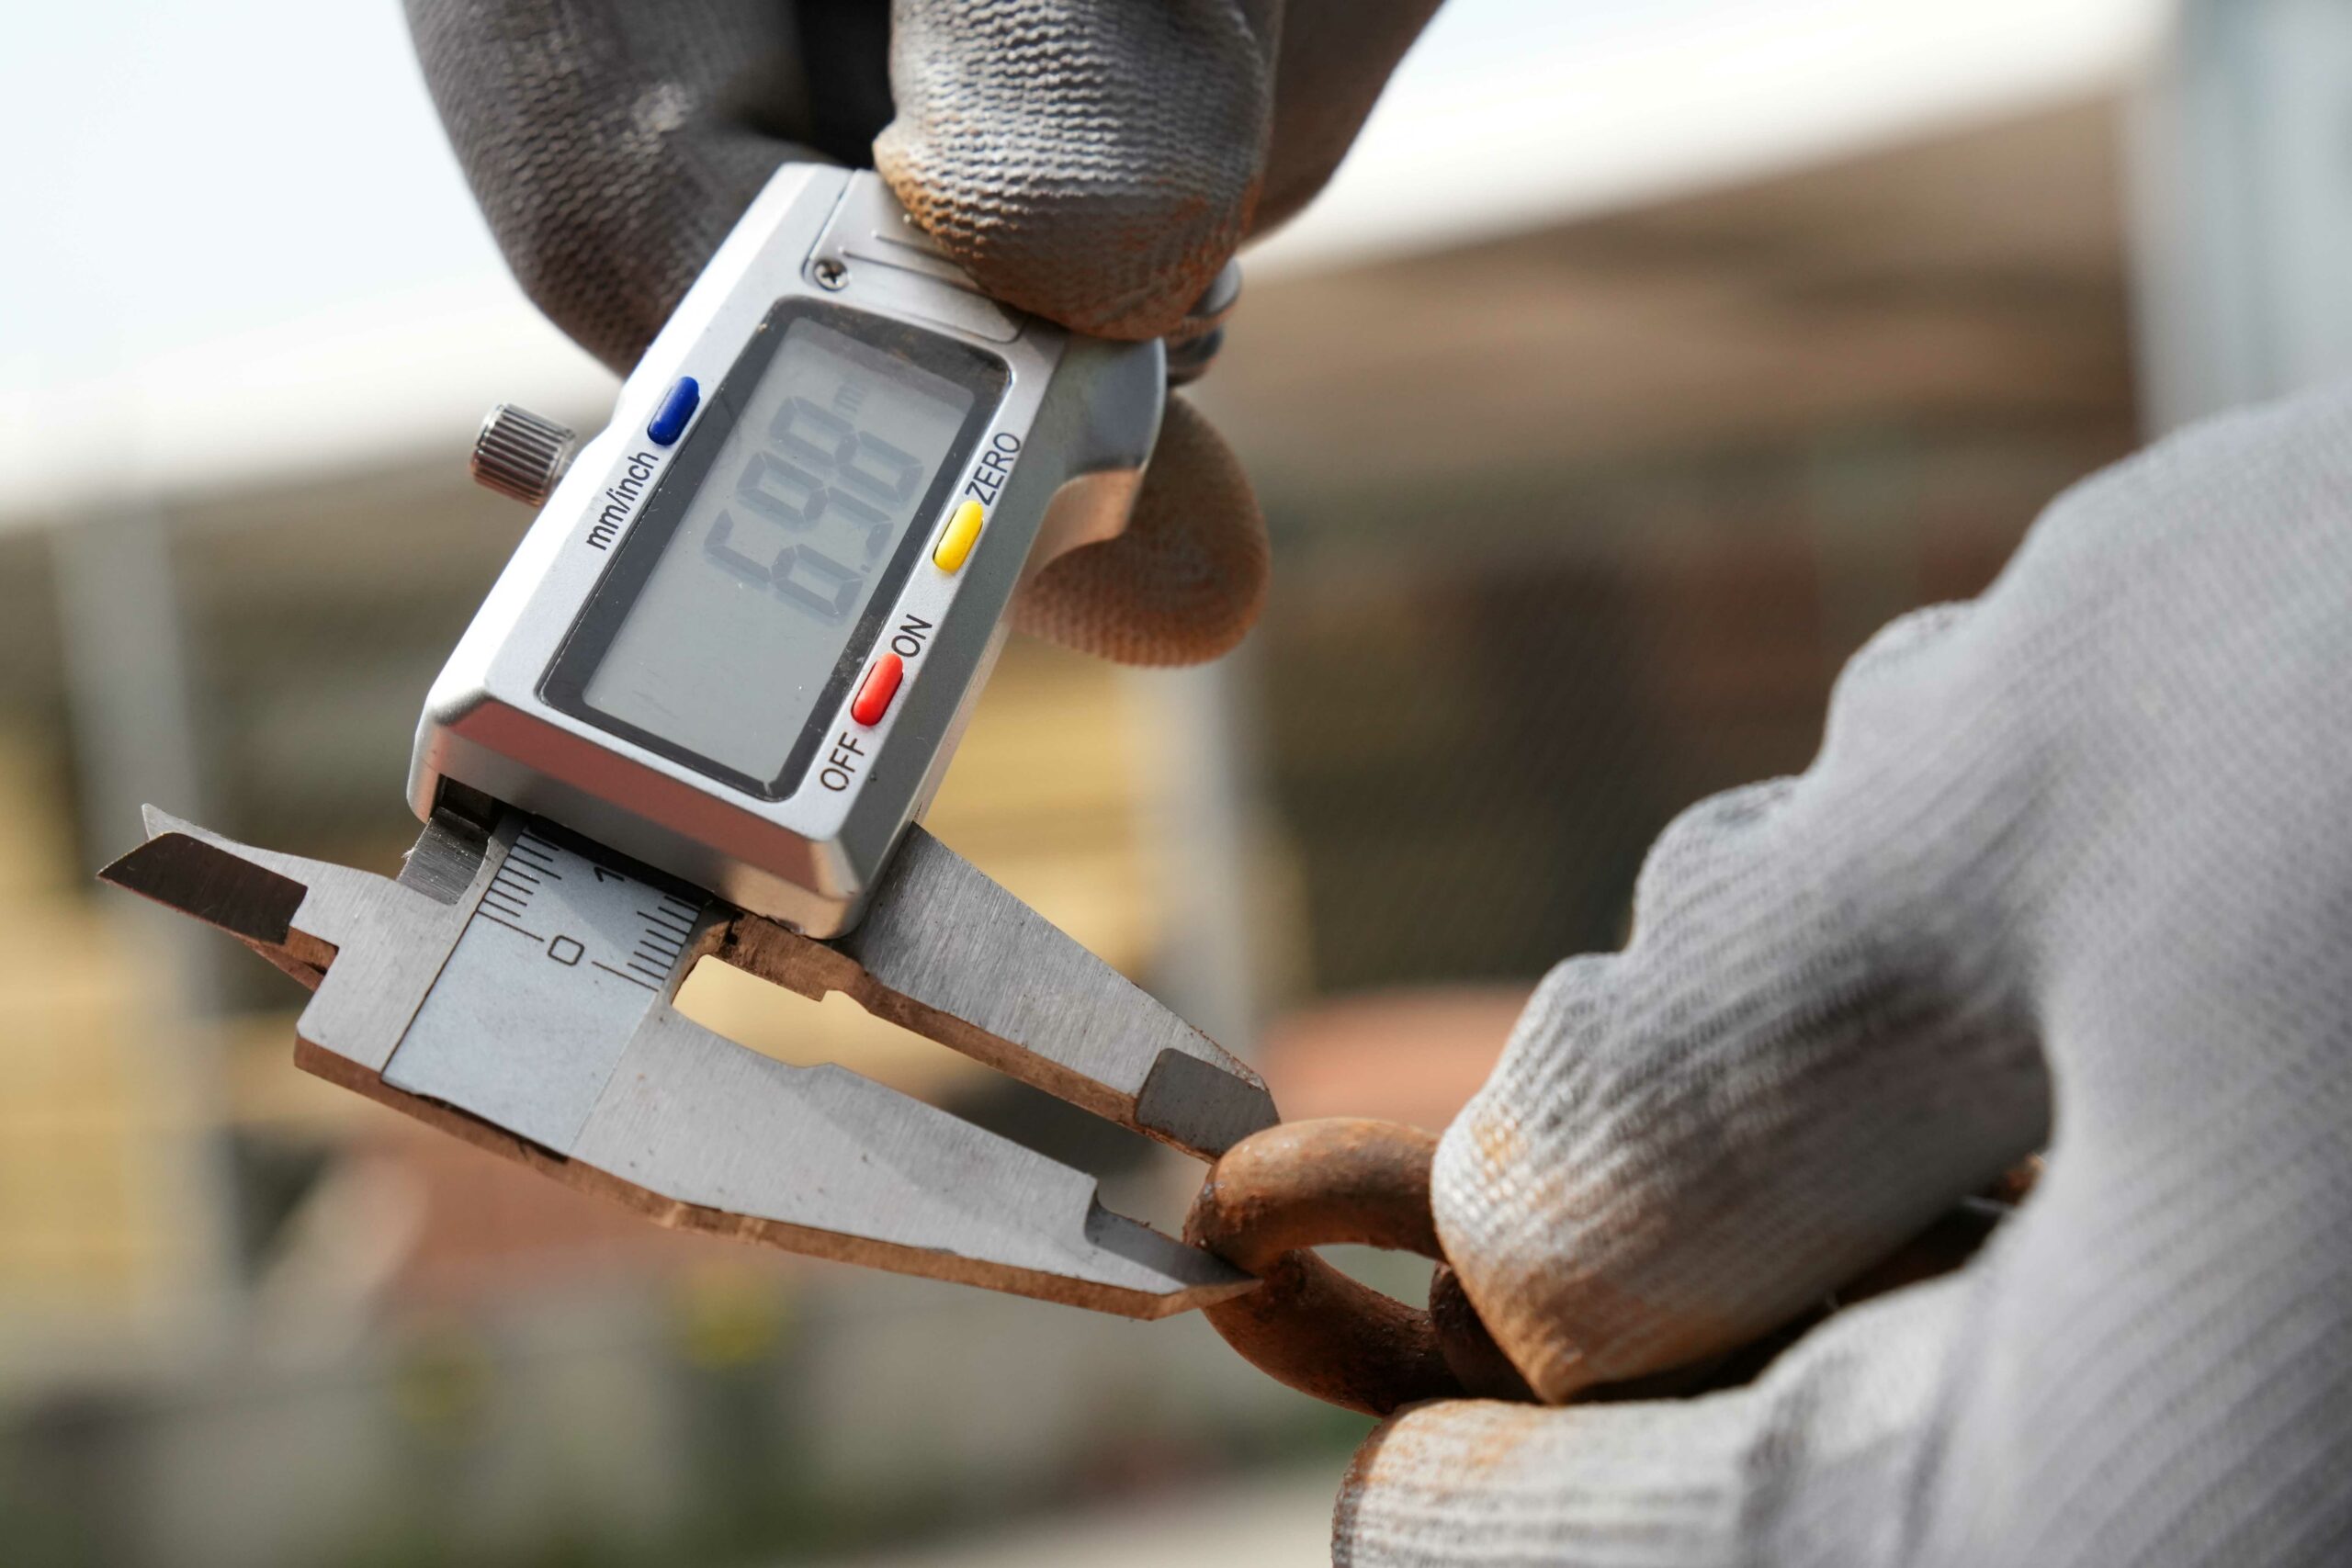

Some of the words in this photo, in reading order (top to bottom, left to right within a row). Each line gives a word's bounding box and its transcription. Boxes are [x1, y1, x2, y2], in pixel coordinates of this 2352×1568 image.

[965, 433, 1021, 506] ZERO
[586, 452, 659, 551] mm/inch
[891, 614, 933, 658] ON
[820, 731, 865, 791] OFF
[548, 935, 584, 966] 0
